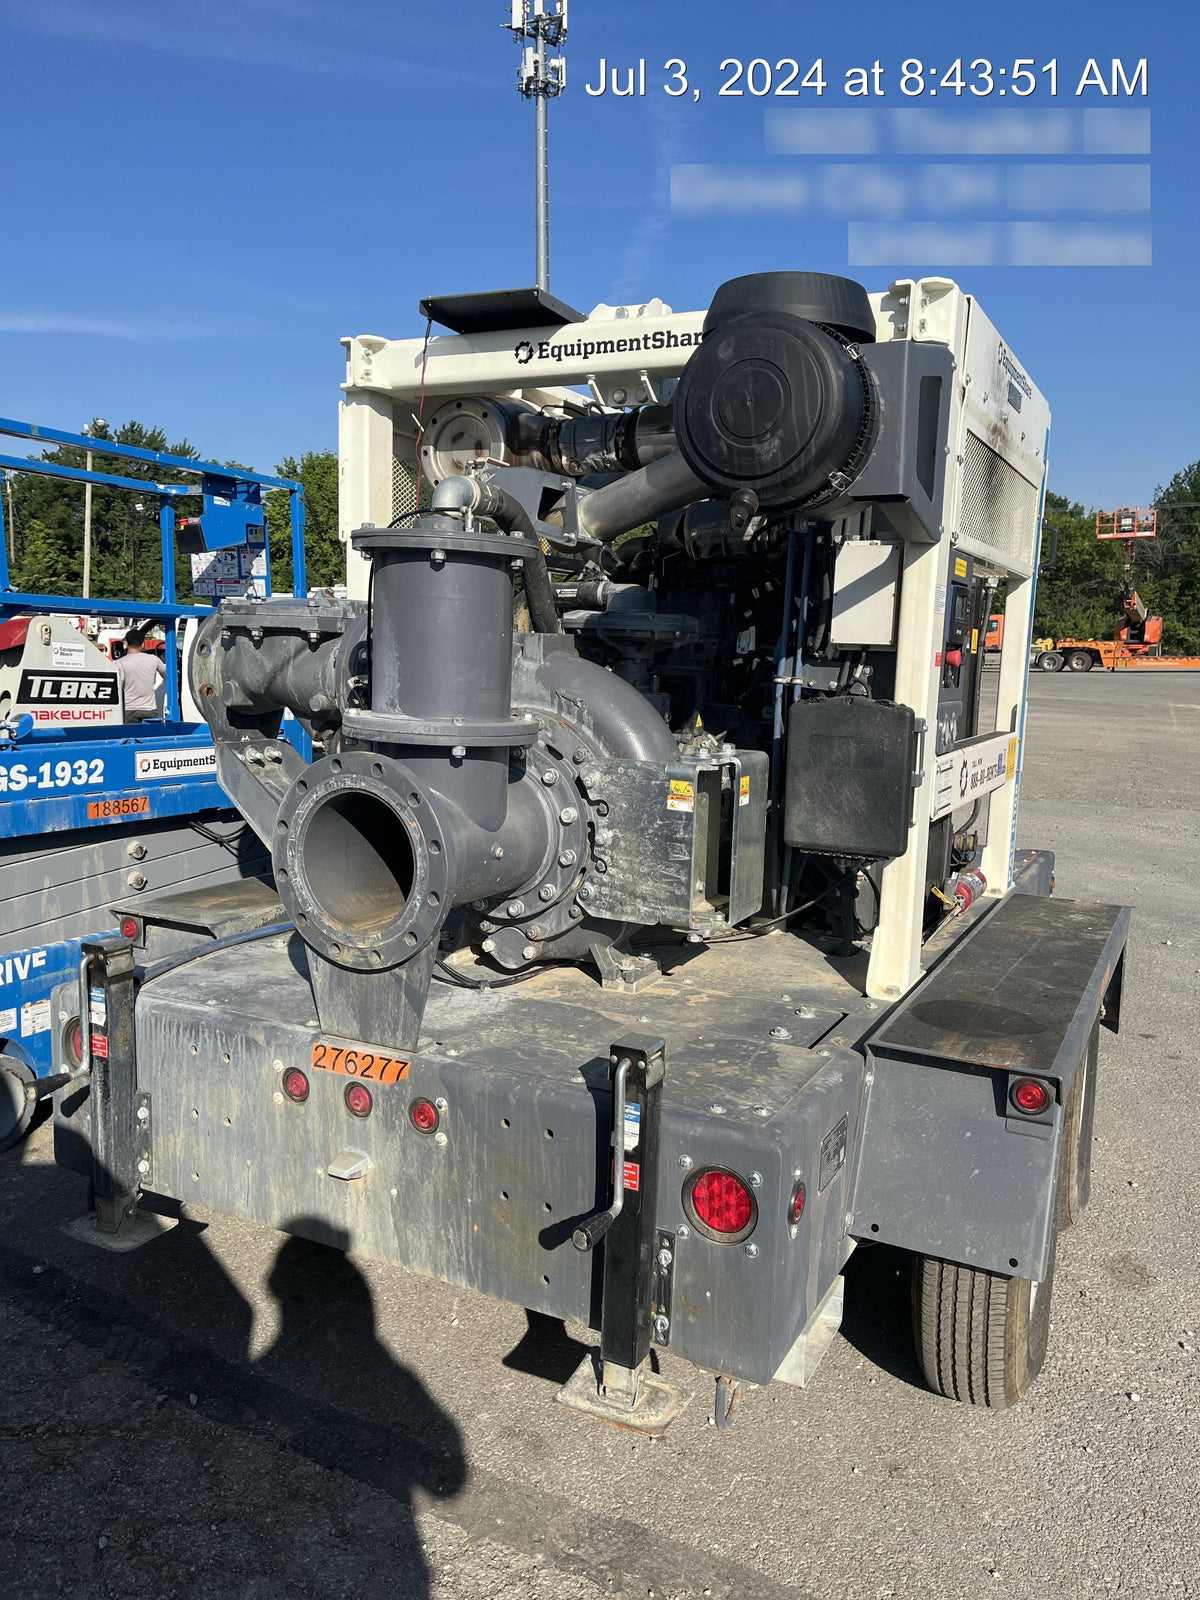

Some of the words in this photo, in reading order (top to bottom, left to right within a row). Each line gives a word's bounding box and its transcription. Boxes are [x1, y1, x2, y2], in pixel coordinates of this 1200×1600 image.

[537, 331, 703, 361] EquipmentShar
[27, 675, 115, 699] TL8R2
[30, 710, 106, 721] TAKEUCHI
[153, 754, 216, 771] EquipmentS
[93, 797, 148, 817] 188567
[313, 1044, 409, 1082] 276277
